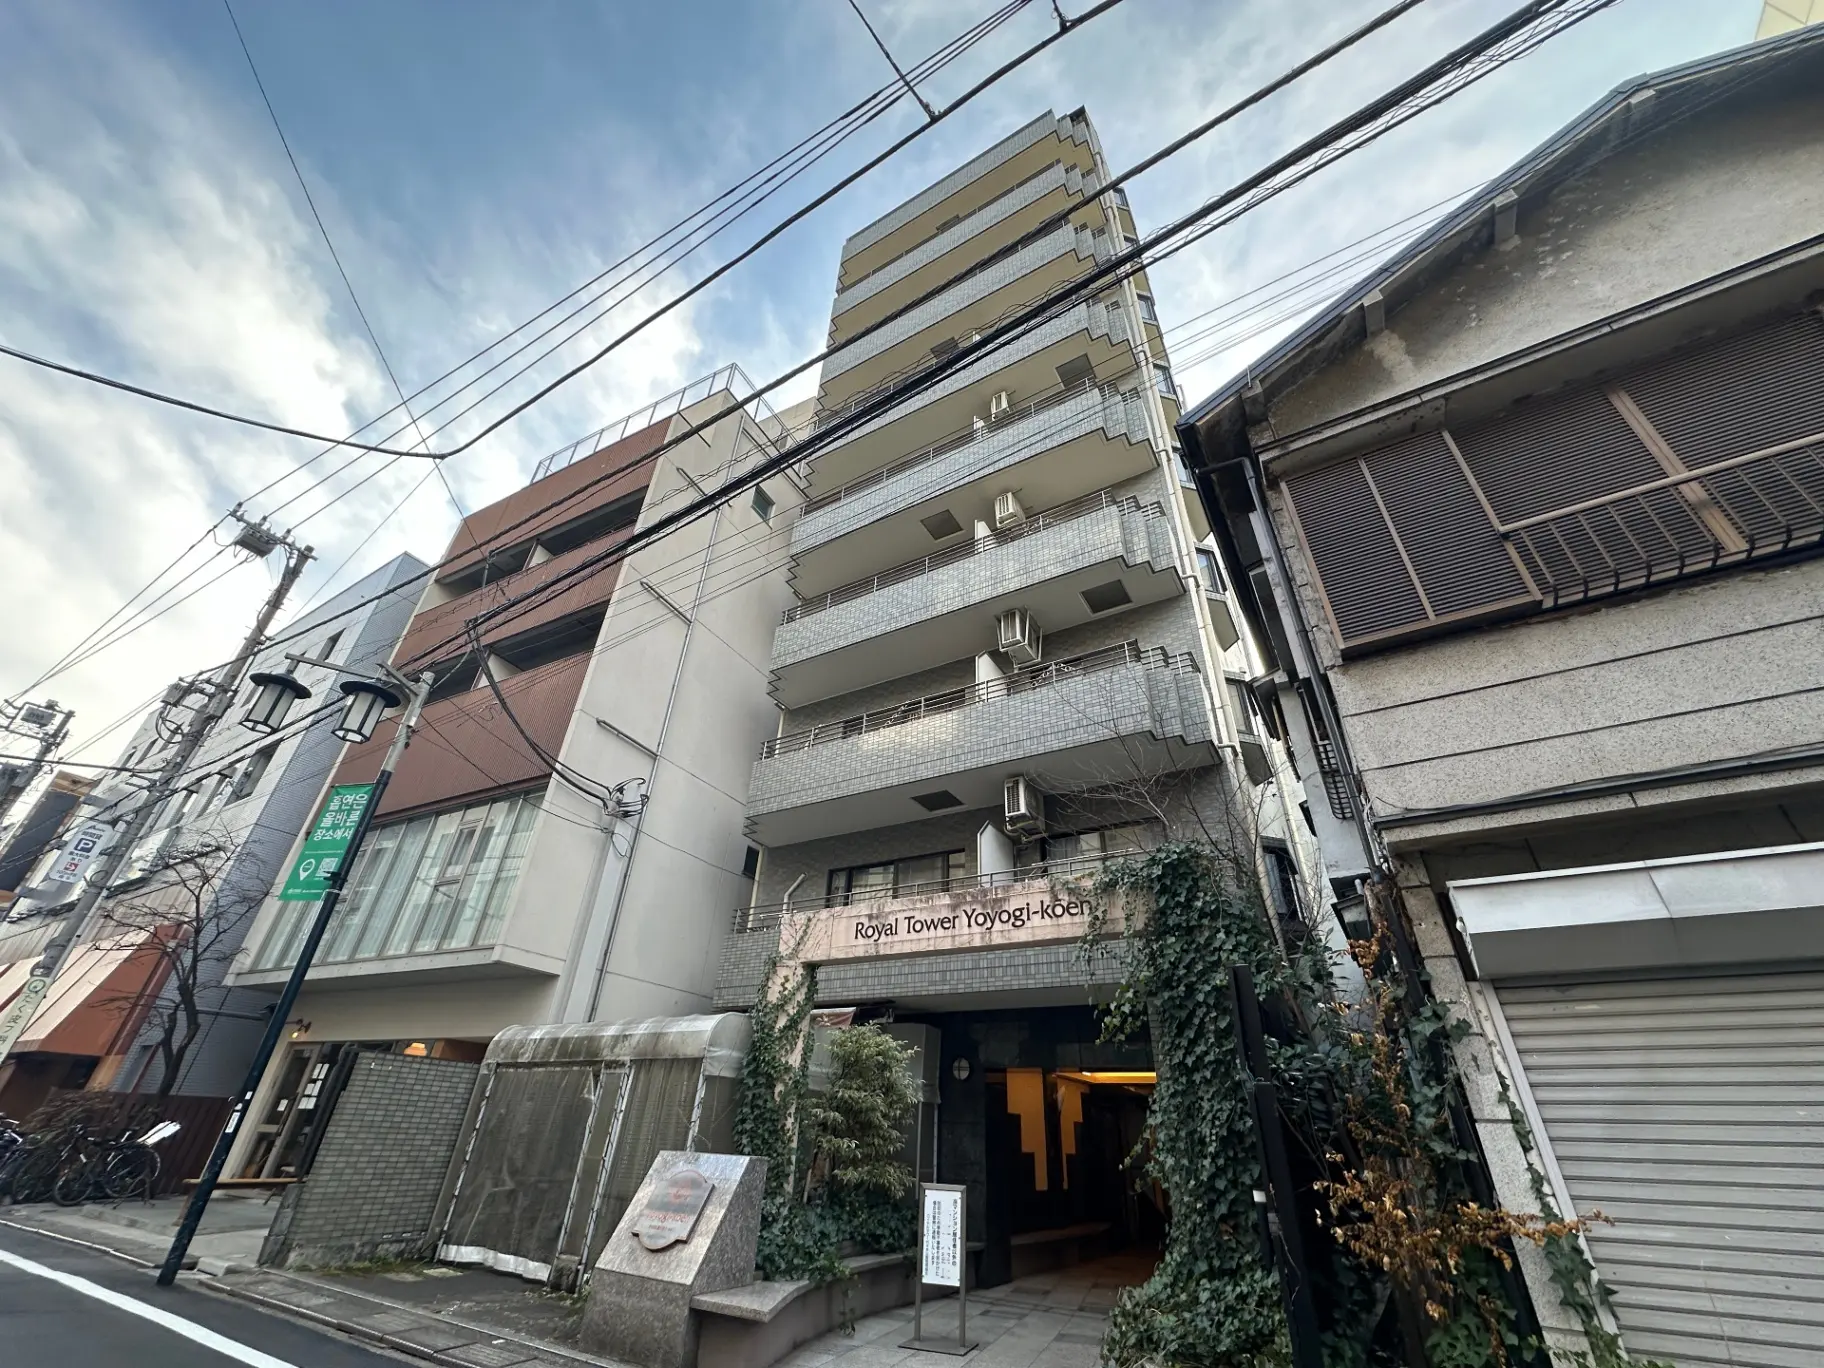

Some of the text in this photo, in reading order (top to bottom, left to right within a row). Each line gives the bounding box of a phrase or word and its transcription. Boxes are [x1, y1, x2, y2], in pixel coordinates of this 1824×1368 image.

[329, 793, 368, 810] 흡연은
[320, 811, 360, 827] 올바른
[313, 827, 354, 841] 장소에서
[854, 917, 898, 942] Royal
[904, 914, 959, 934] Tower
